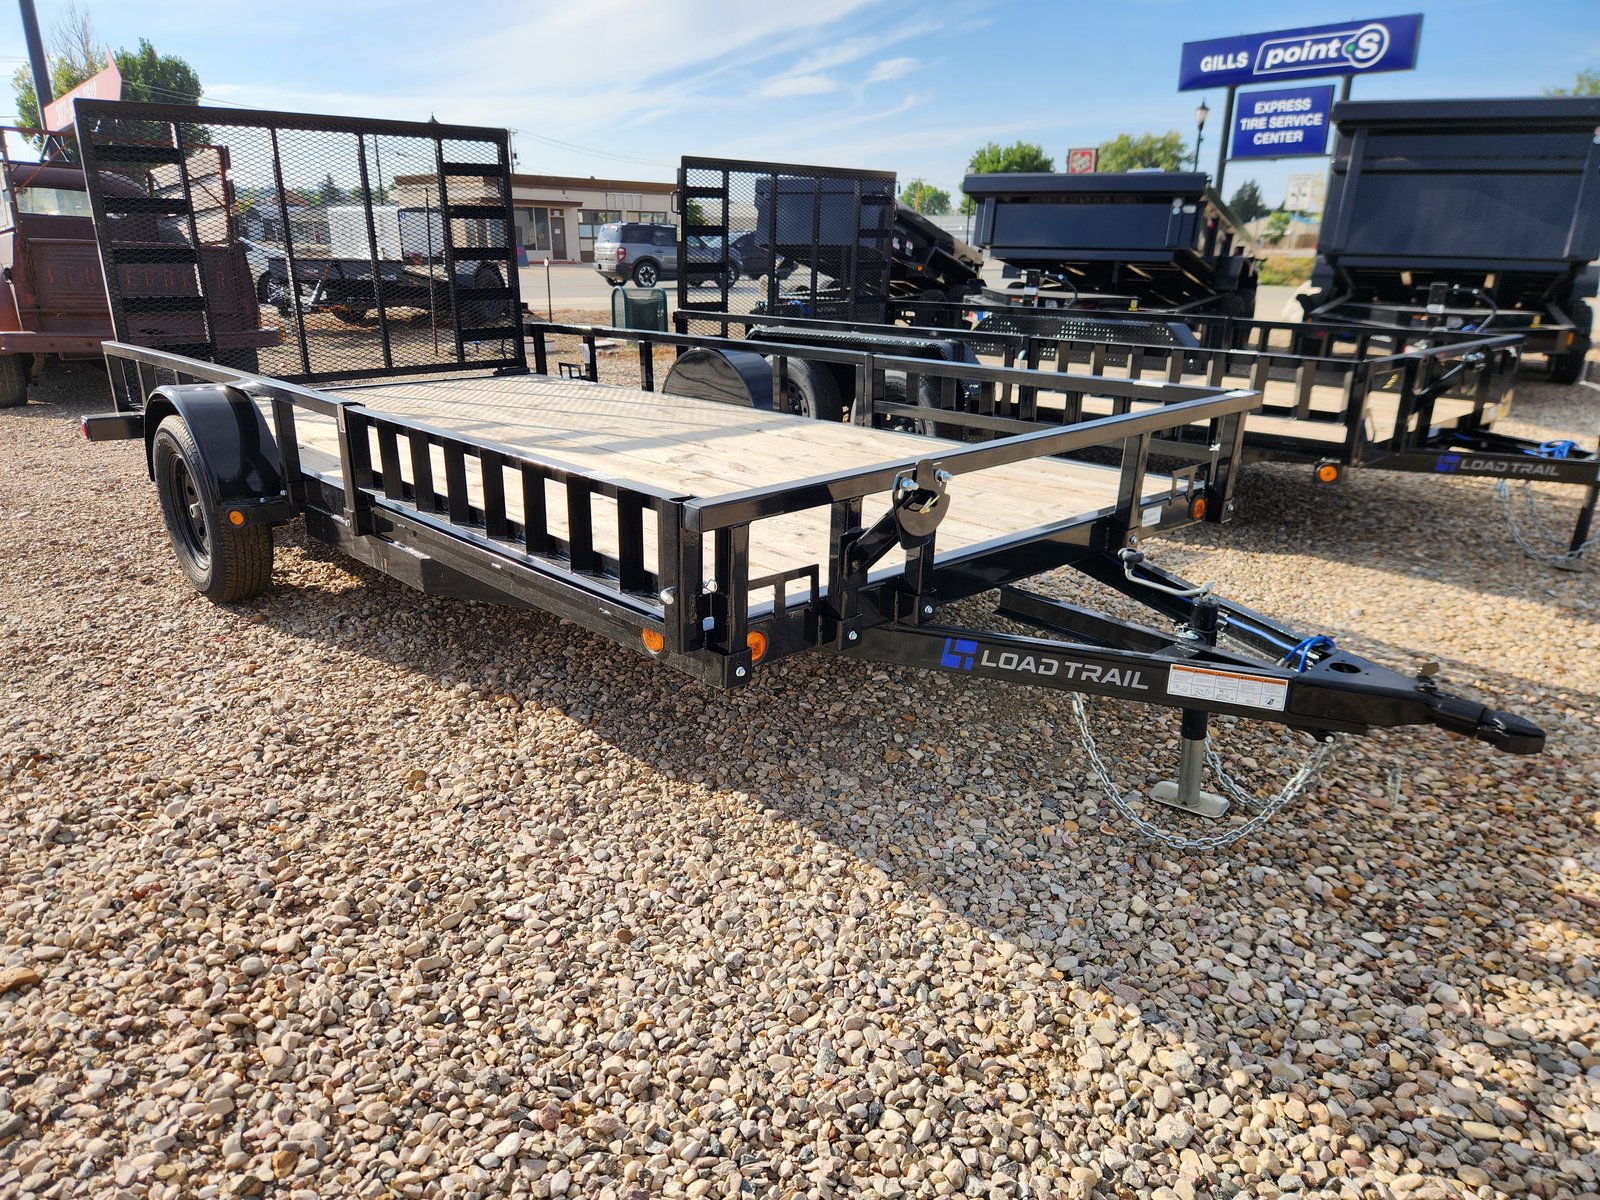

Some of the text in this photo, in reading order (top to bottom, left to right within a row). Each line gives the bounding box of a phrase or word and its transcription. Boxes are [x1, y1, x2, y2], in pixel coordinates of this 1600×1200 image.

[1201, 31, 1381, 72] GILLS point S
[1254, 97, 1312, 115] EXPRESS
[1240, 112, 1324, 131] TIRE SERVICE
[1253, 129, 1304, 145] CENTER
[1460, 459, 1560, 477] LOAD TRAIL
[980, 649, 1059, 676] LOAD
[1064, 661, 1149, 690] TRAIL
